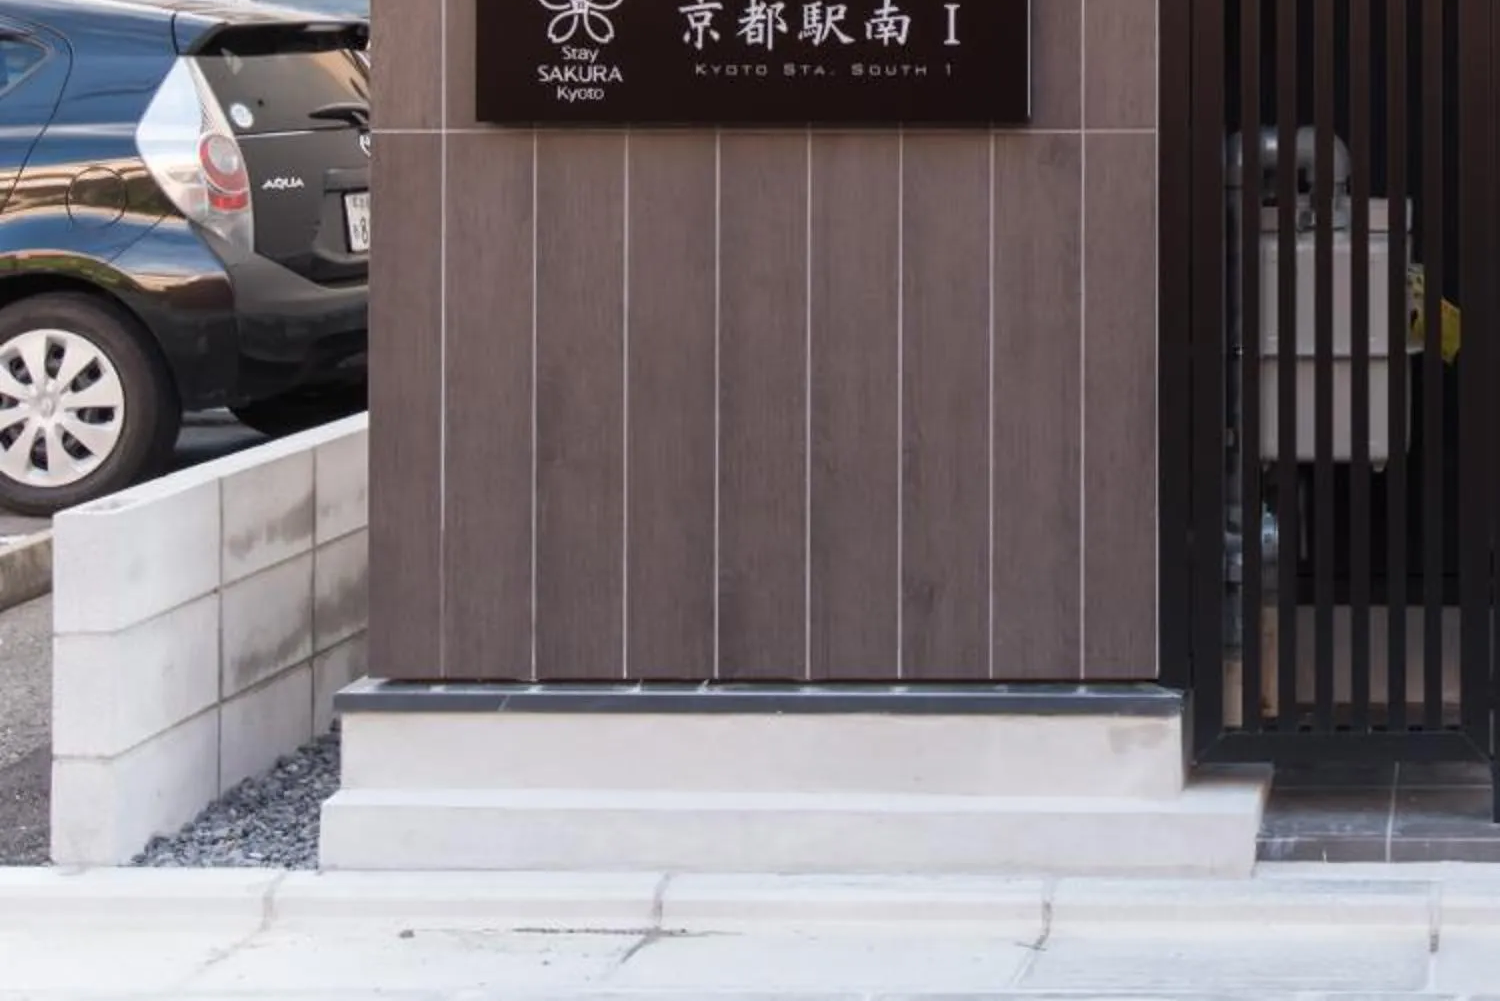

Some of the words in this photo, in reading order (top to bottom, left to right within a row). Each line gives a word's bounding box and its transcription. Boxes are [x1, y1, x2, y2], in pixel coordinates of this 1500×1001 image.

[561, 45, 600, 63] Stay
[537, 65, 624, 82] SAKURA
[556, 85, 605, 103] Kyoto
[261, 177, 304, 190] AQUA
